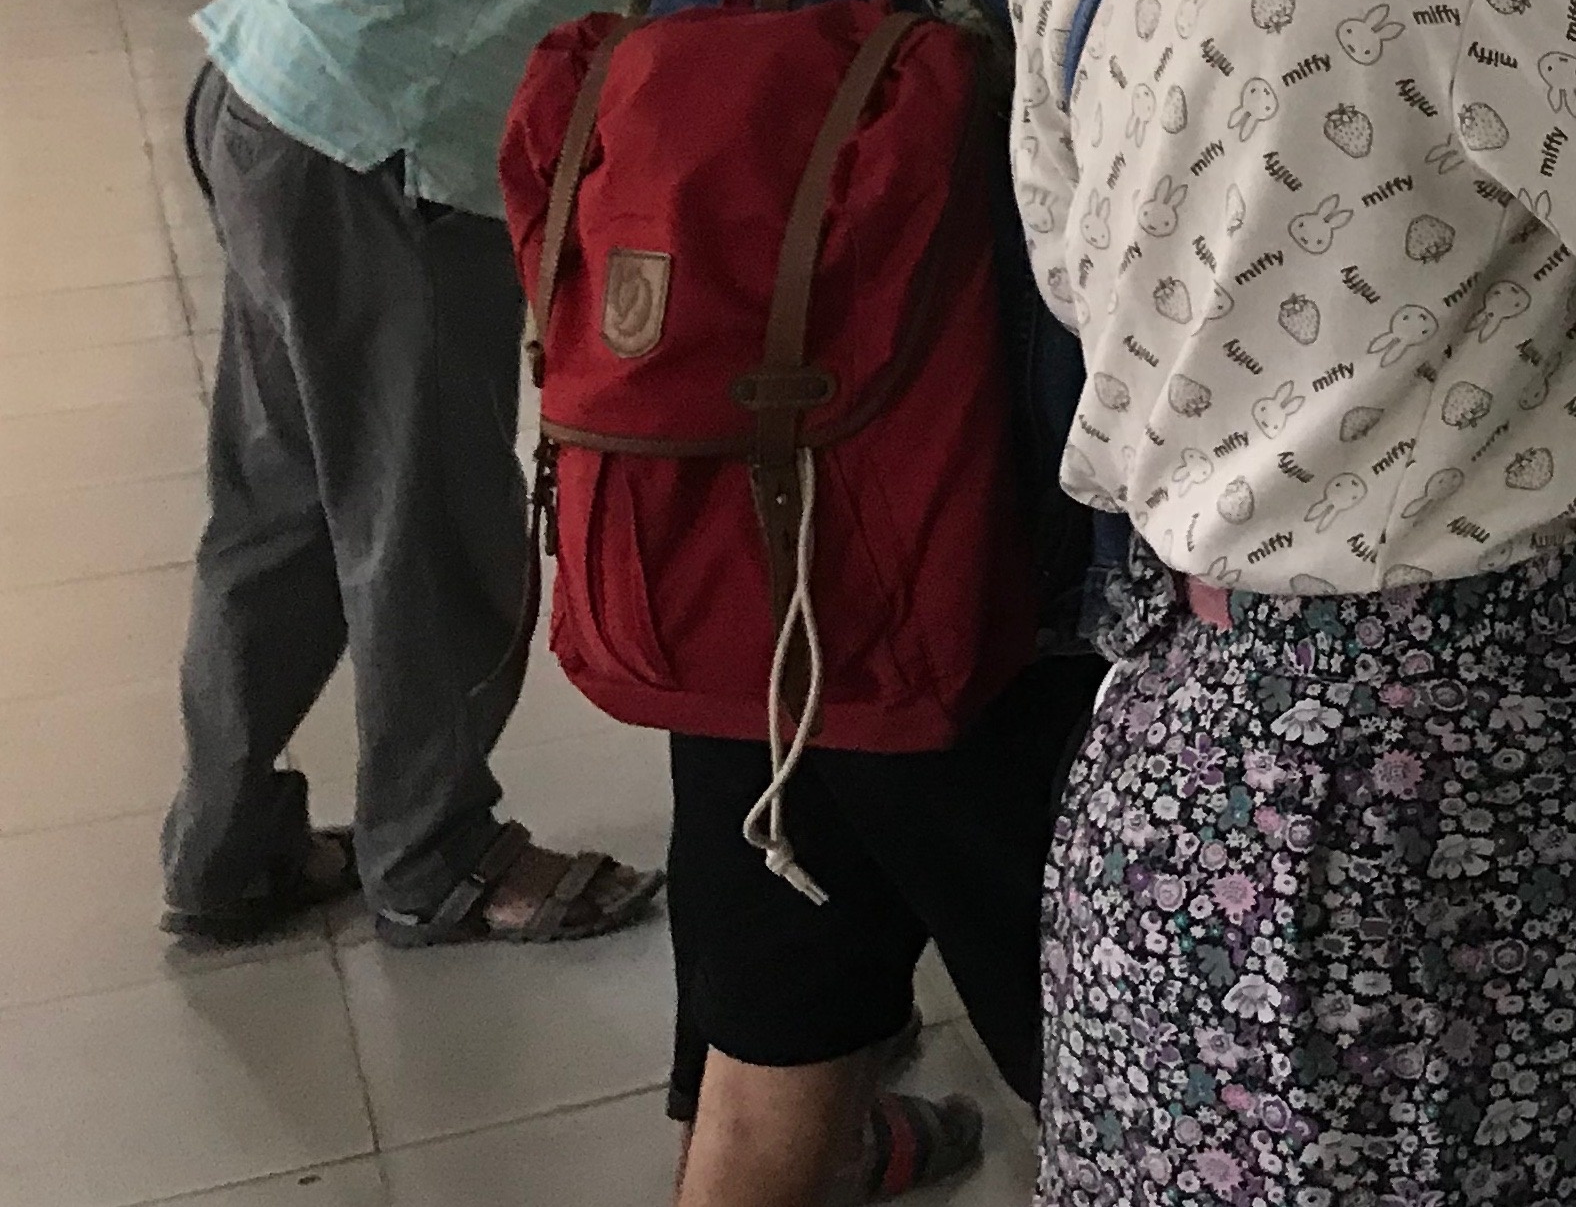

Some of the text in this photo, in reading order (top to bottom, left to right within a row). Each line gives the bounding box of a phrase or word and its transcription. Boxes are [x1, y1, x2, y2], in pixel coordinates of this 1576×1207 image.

[1412, 4, 1461, 26] miffy
[1200, 37, 1235, 77] miffy
[1282, 53, 1332, 87] miffy
[1468, 41, 1518, 69] miffy
[1395, 78, 1438, 117] miffy
[1190, 139, 1225, 176] miffy
[1540, 126, 1569, 177] miffy
[1263, 151, 1303, 192] miffy
[1361, 174, 1414, 207] miffy
[1235, 249, 1285, 286] miffy
[1340, 264, 1381, 304] miffy
[1123, 334, 1159, 368] miffy
[1223, 338, 1263, 375] miffy
[1312, 362, 1355, 393] miffy
[1213, 430, 1250, 460] miffy
[1277, 450, 1315, 484] miffy
[1447, 516, 1491, 543] miffy
[1247, 531, 1295, 564] miffy
